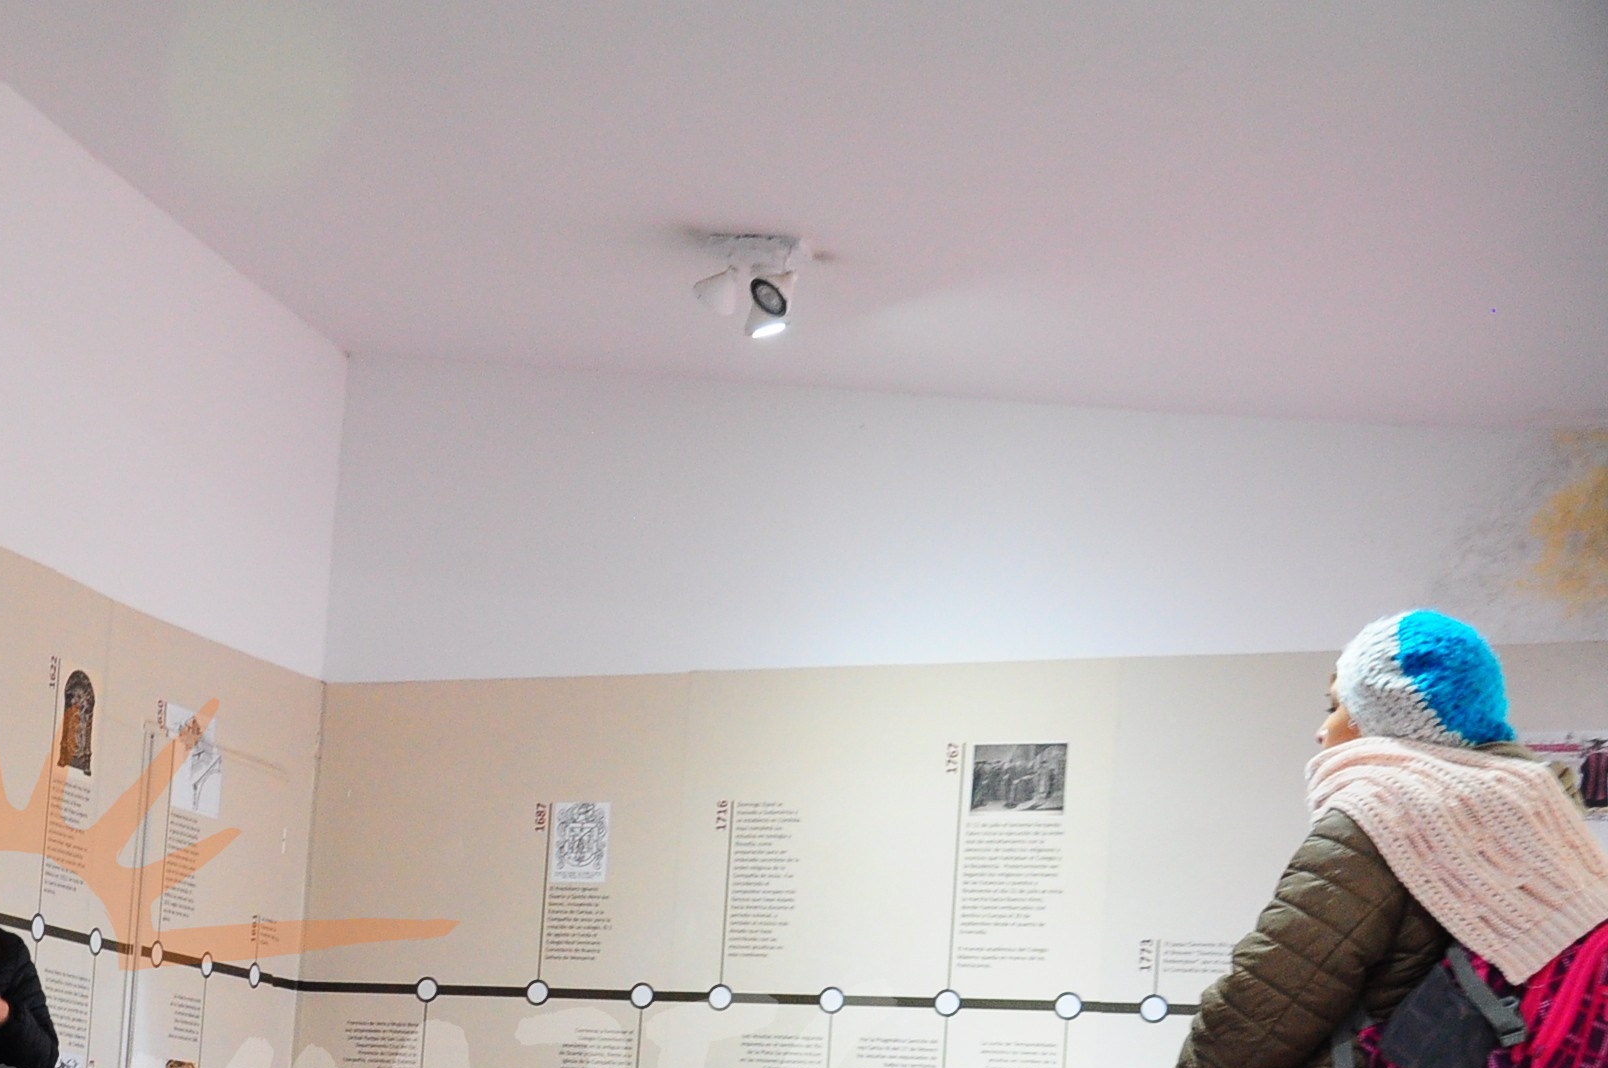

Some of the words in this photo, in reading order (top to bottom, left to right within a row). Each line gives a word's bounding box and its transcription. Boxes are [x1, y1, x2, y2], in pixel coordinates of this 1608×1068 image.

[49, 655, 58, 689] 1622
[946, 743, 959, 773] 1767
[534, 803, 546, 833] 1687
[715, 800, 728, 831] 1716
